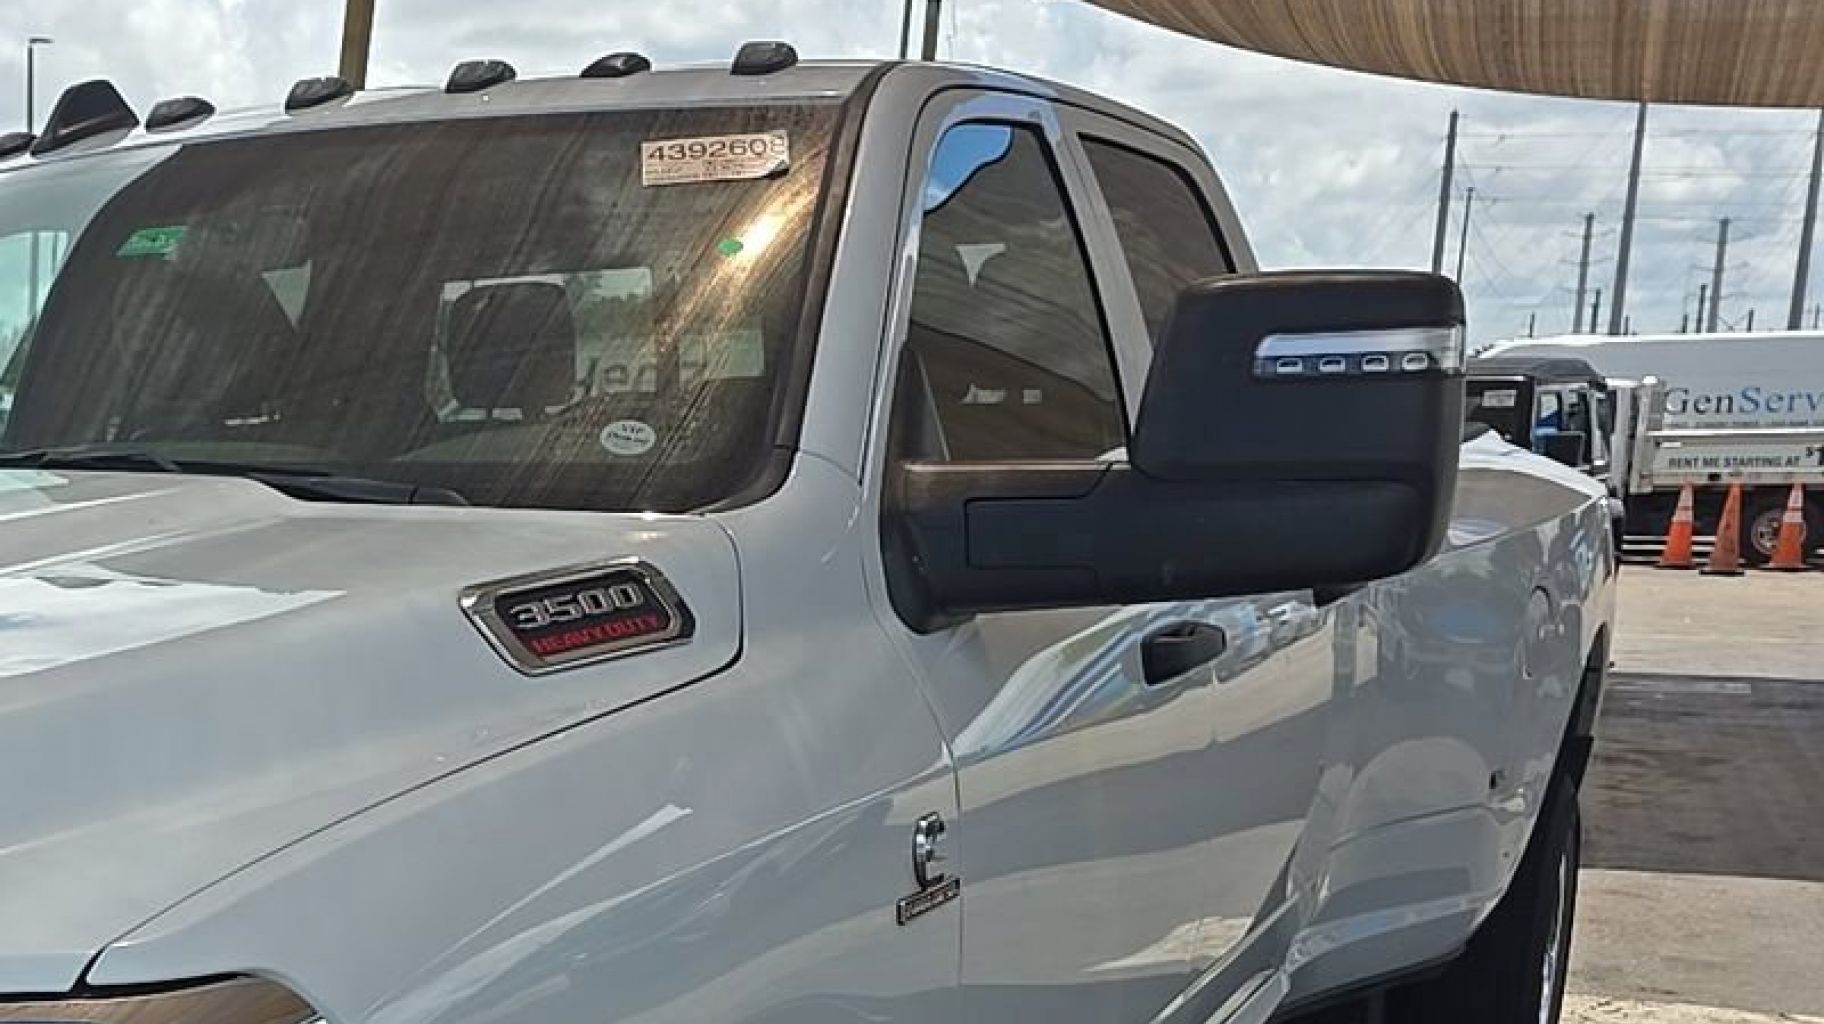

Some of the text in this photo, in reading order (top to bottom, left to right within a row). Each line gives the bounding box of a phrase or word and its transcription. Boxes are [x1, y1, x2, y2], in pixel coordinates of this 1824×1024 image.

[1668, 455, 1699, 468] RENT
[1702, 455, 1720, 468] ME
[1785, 455, 1801, 468] AT
[509, 583, 645, 629] 3500
